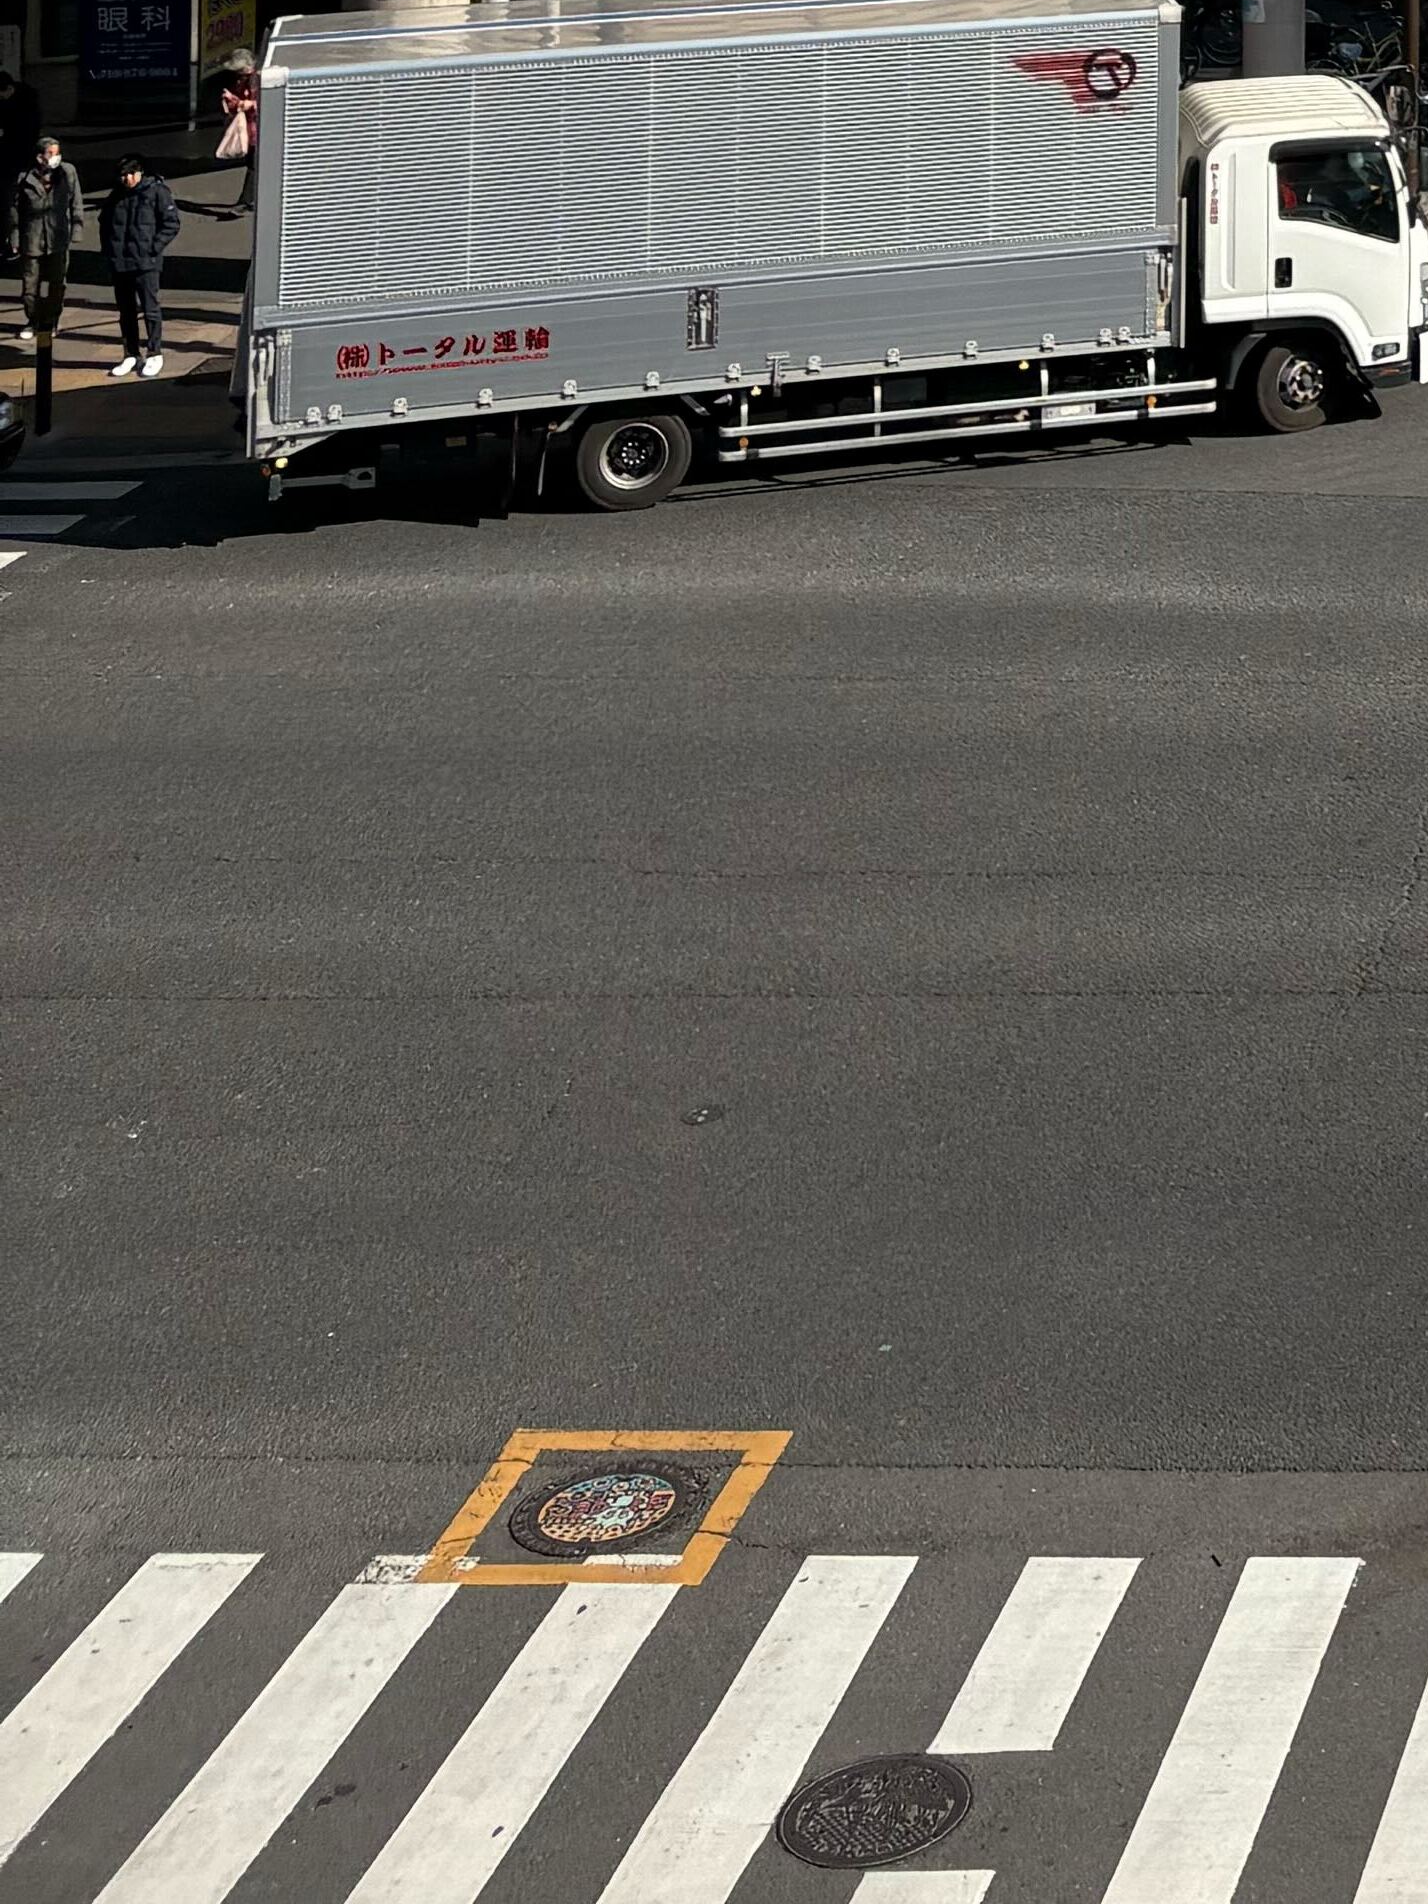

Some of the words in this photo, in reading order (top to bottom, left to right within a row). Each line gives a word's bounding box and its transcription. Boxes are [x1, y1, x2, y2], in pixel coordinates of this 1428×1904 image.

[97, 7, 173, 33] 眼科
[336, 326, 550, 371] (株)トータル運輸
